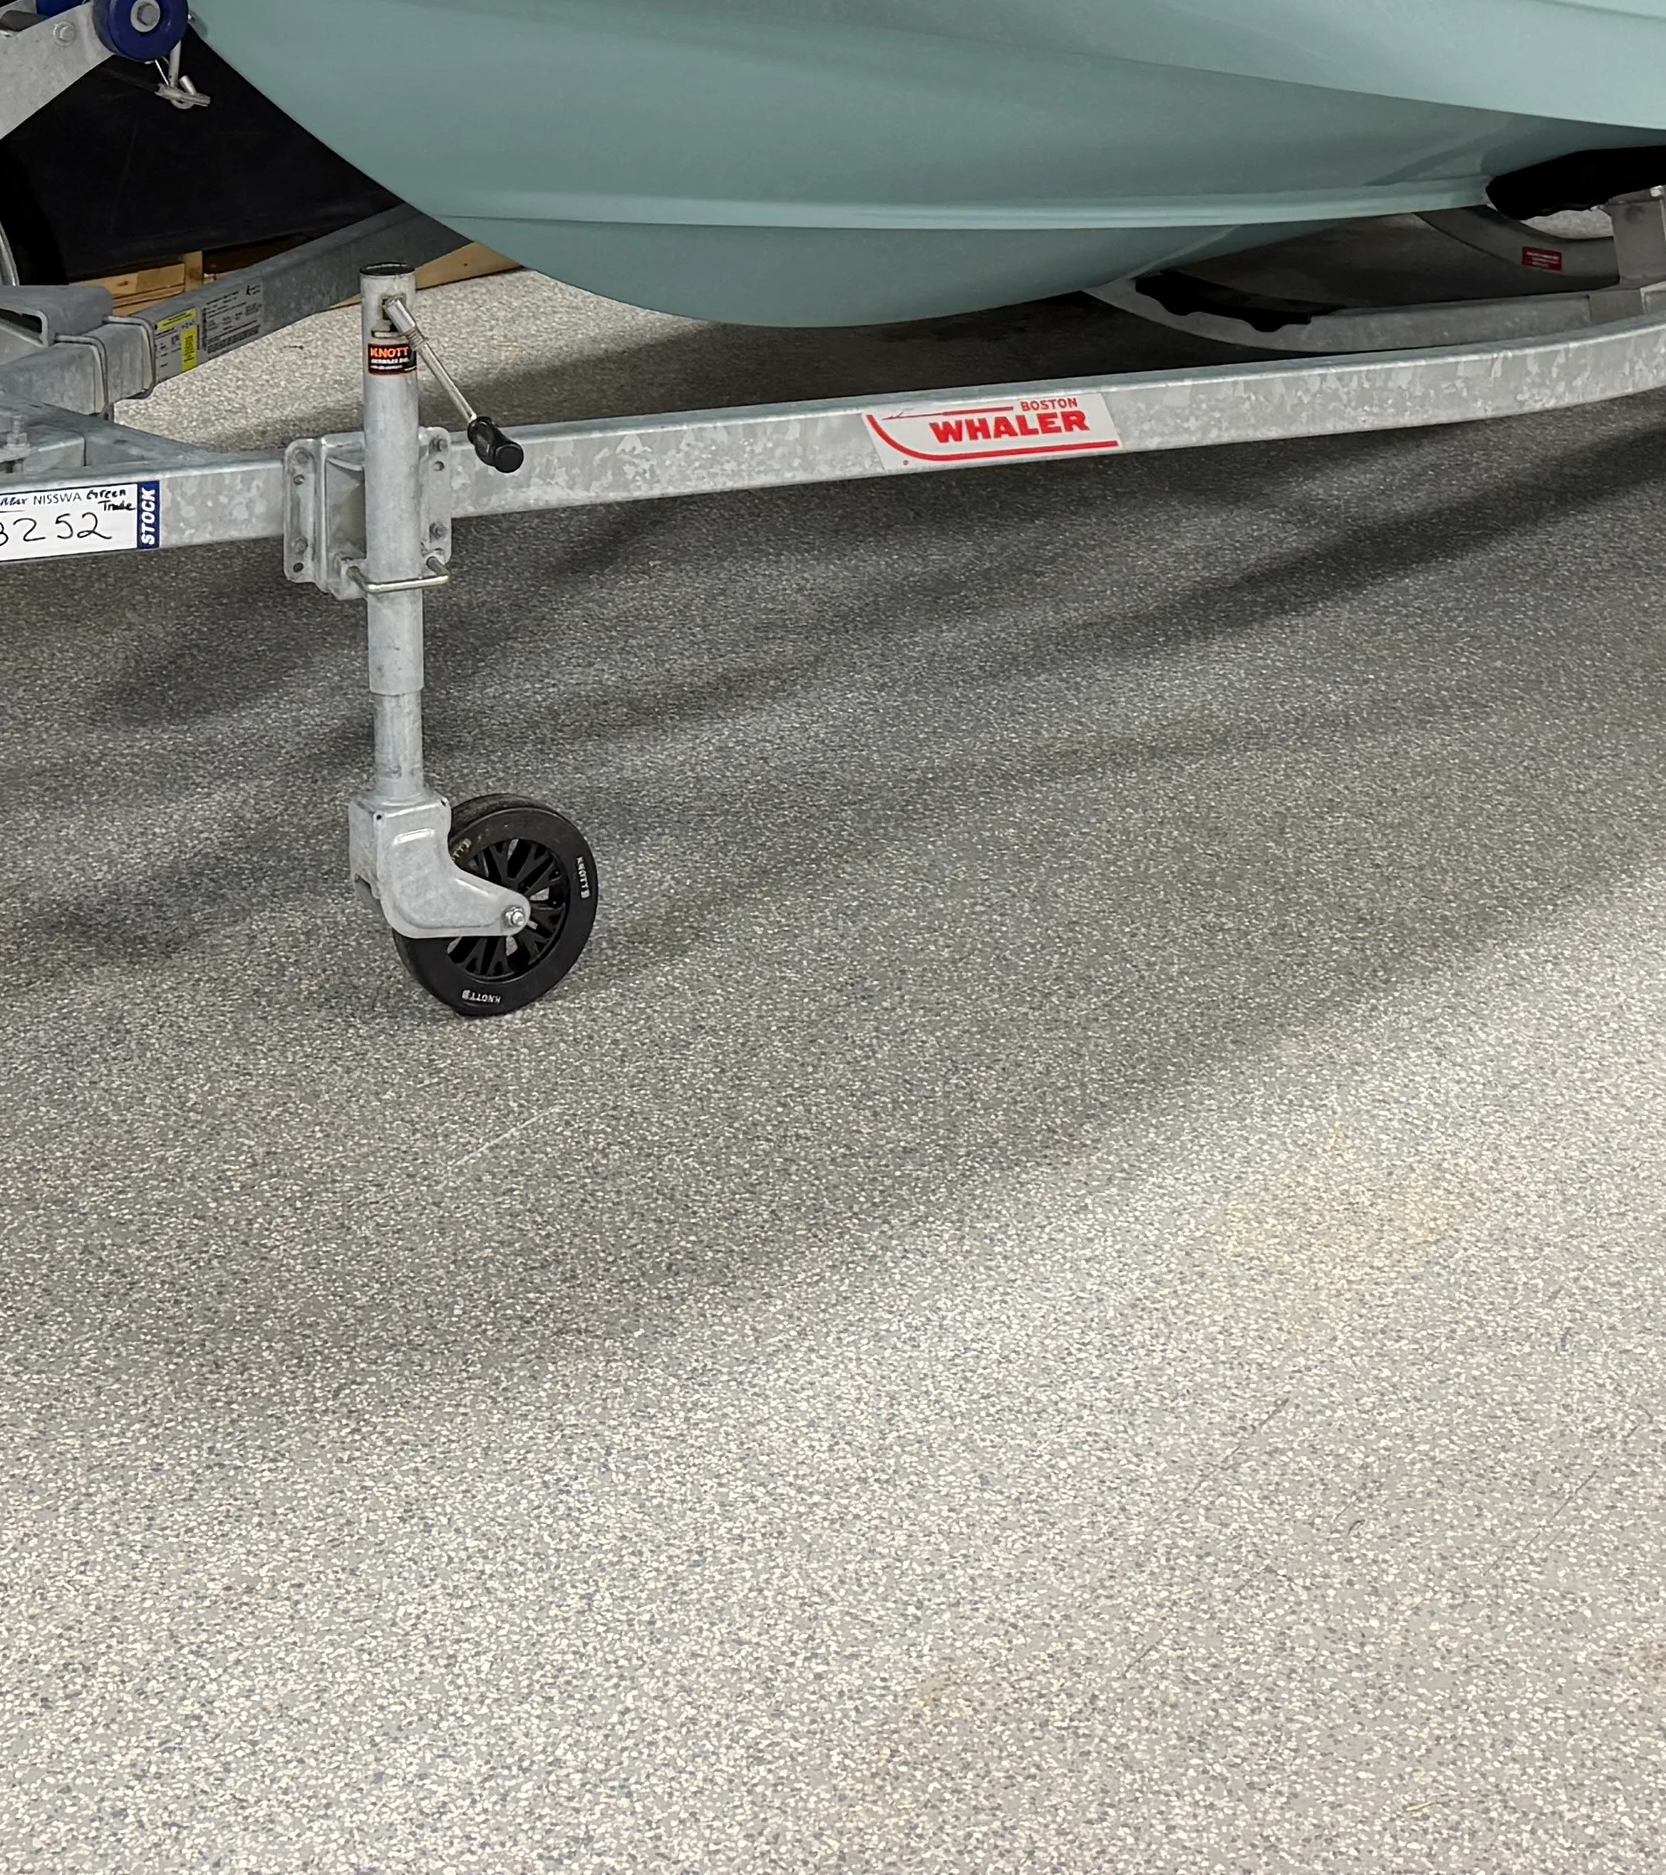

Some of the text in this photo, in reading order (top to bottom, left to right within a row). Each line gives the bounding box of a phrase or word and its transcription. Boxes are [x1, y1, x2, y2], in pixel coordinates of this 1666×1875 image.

[370, 346, 409, 358] KNOTT
[1020, 397, 1078, 412] BOSTON
[929, 410, 1090, 443] WHALER
[33, 492, 82, 506] NISSWA
[86, 489, 126, 500] Green
[141, 487, 156, 545] STOCK
